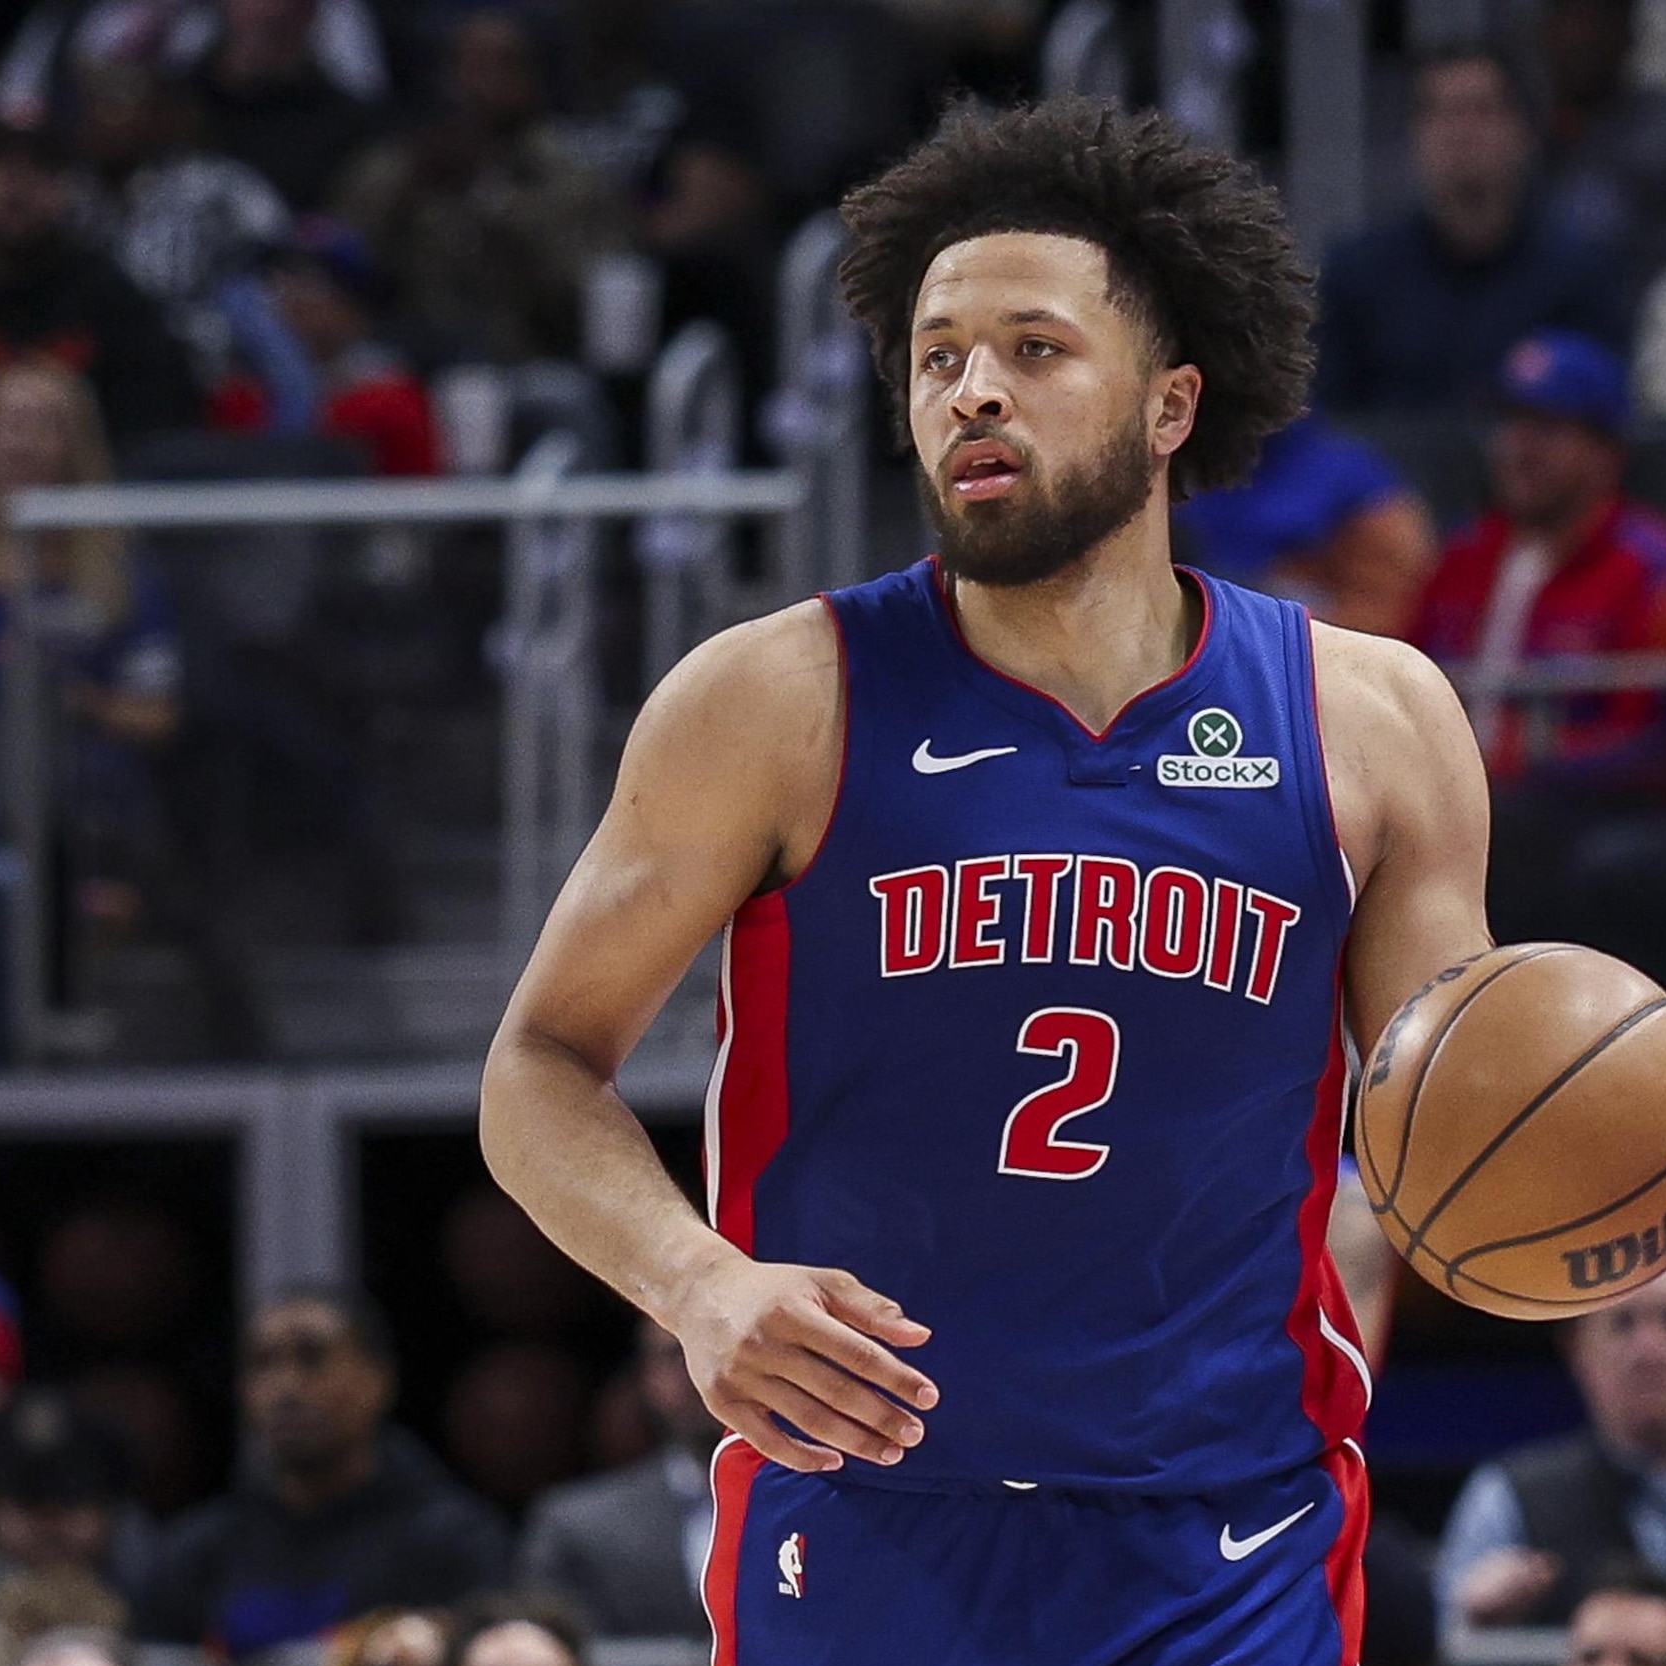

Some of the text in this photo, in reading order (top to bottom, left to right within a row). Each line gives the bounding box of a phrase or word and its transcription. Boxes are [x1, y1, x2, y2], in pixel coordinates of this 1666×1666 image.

[1162, 760, 1274, 783] StockX
[869, 854, 1301, 1006] DETROIT
[997, 1006, 1121, 1181] 2
